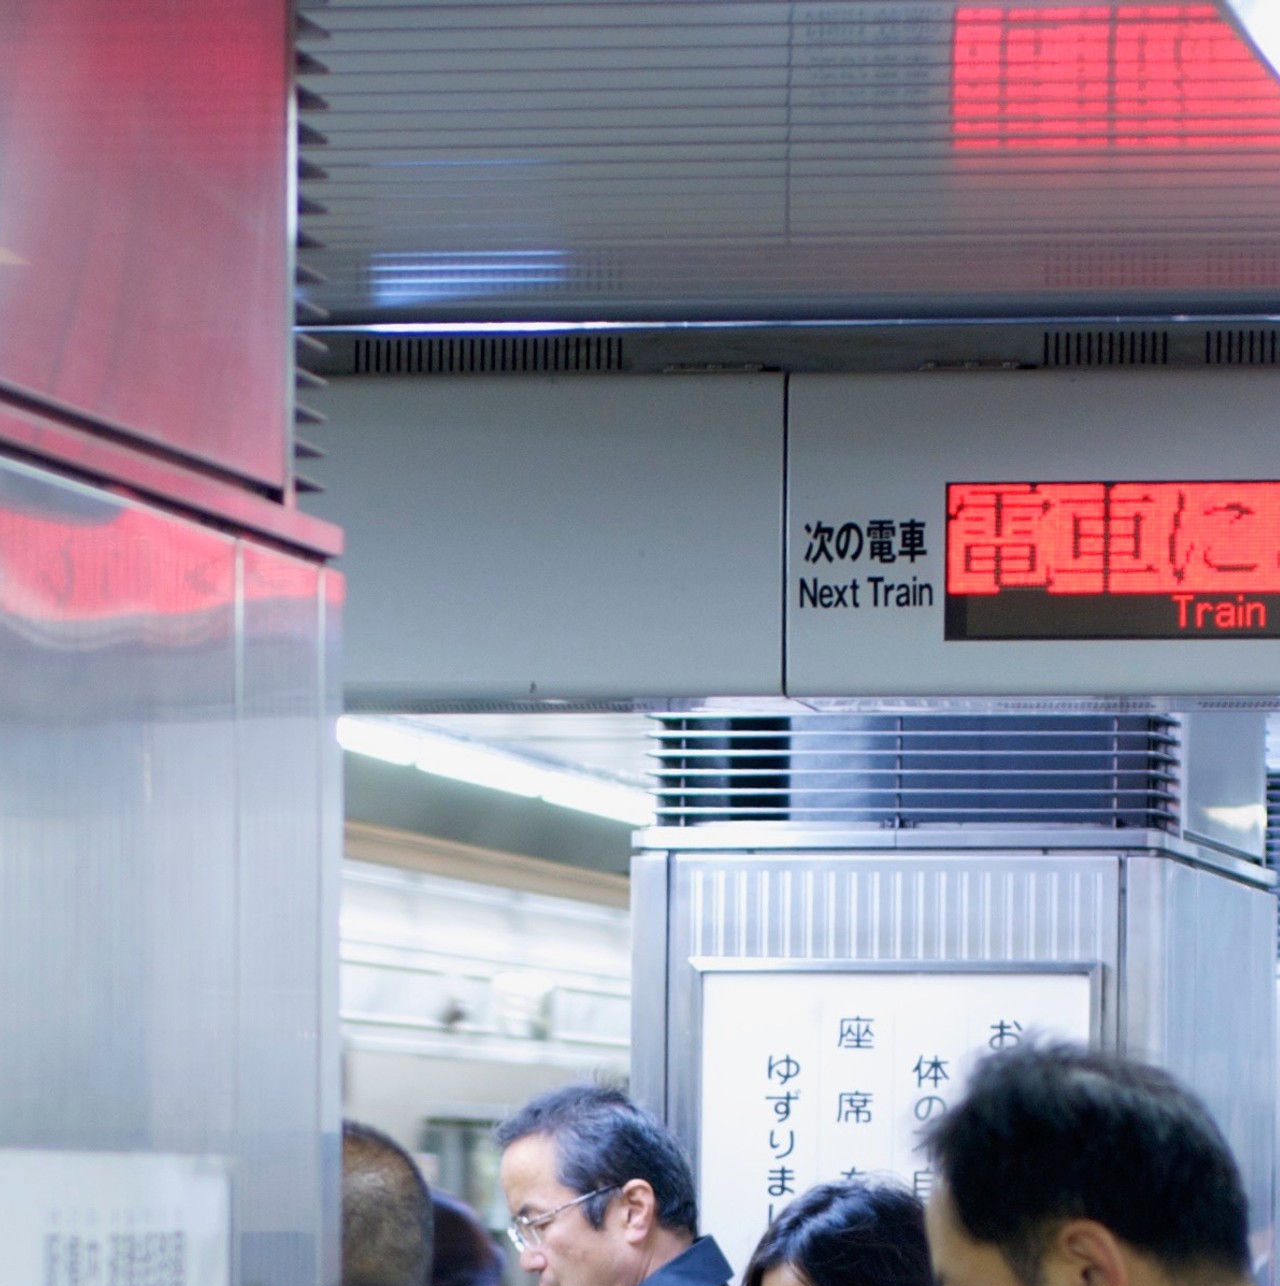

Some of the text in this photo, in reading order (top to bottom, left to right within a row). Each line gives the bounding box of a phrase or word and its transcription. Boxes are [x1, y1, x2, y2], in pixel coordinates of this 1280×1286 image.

[804, 519, 928, 564] 次の電車
[799, 576, 934, 608] Next Train
[1171, 594, 1267, 628] Train
[836, 1015, 875, 1180] 座席
